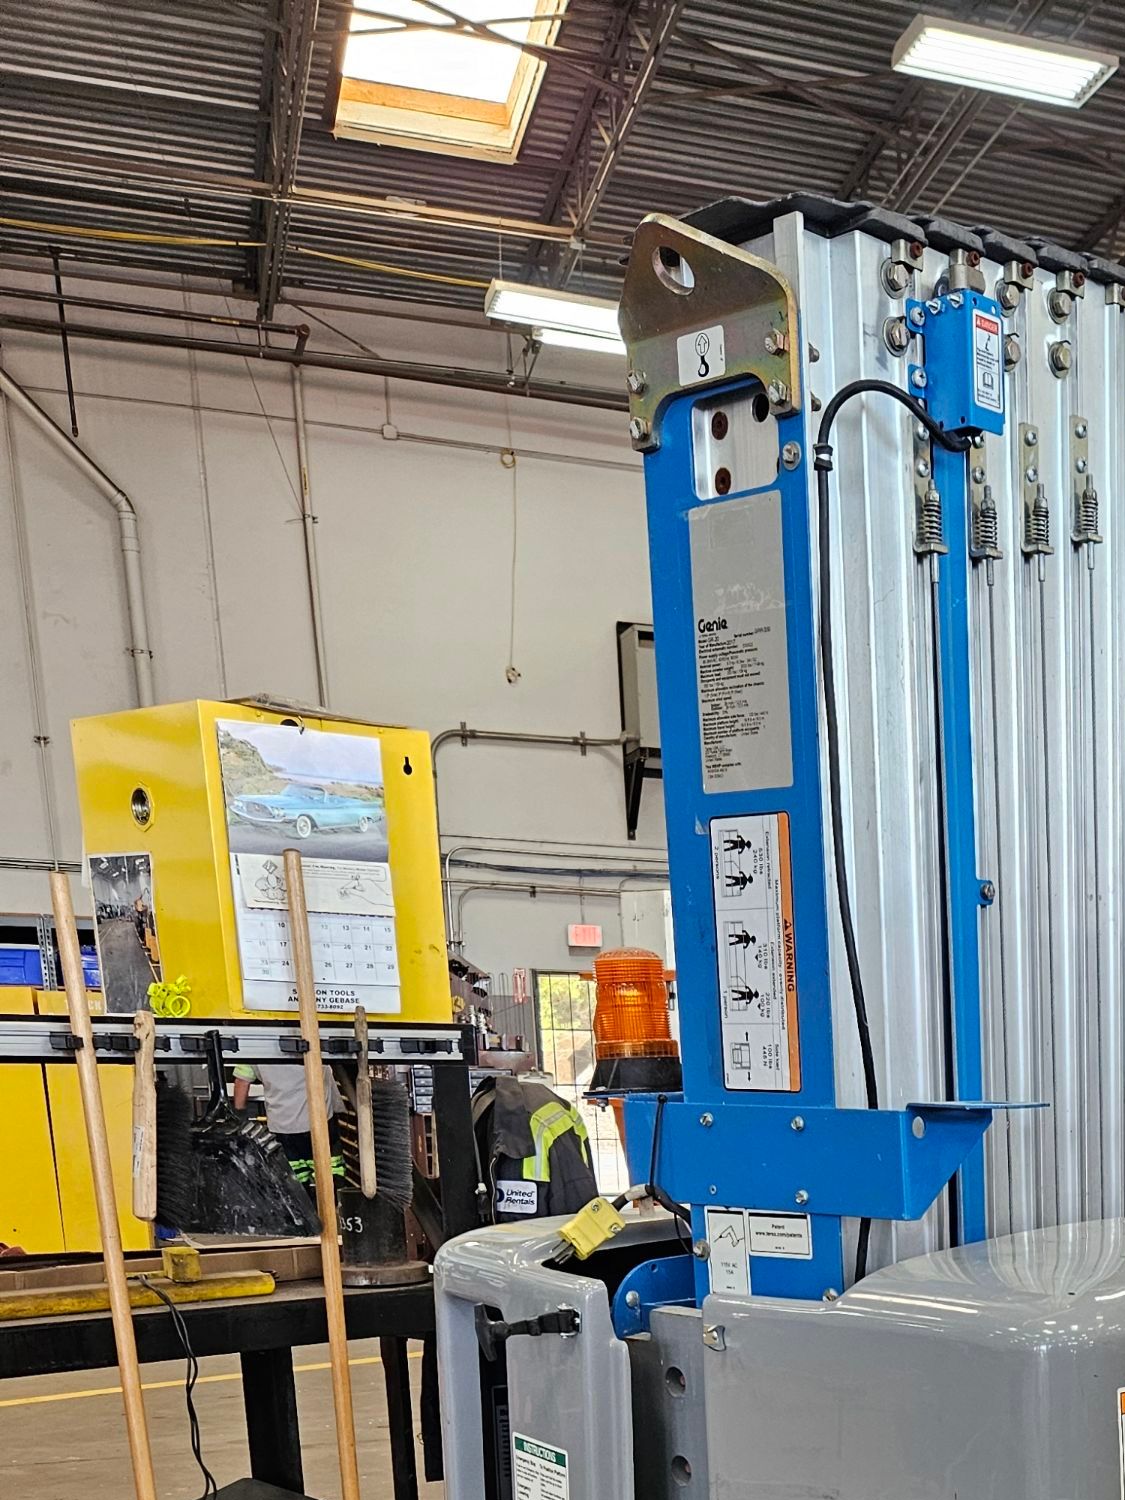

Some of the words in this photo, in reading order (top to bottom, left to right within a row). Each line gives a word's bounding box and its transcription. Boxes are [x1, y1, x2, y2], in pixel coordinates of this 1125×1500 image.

[698, 616, 728, 633] Genie
[785, 932, 795, 992] WARNING
[506, 1188, 534, 1198] United
[504, 1196, 535, 1206] Rentals
